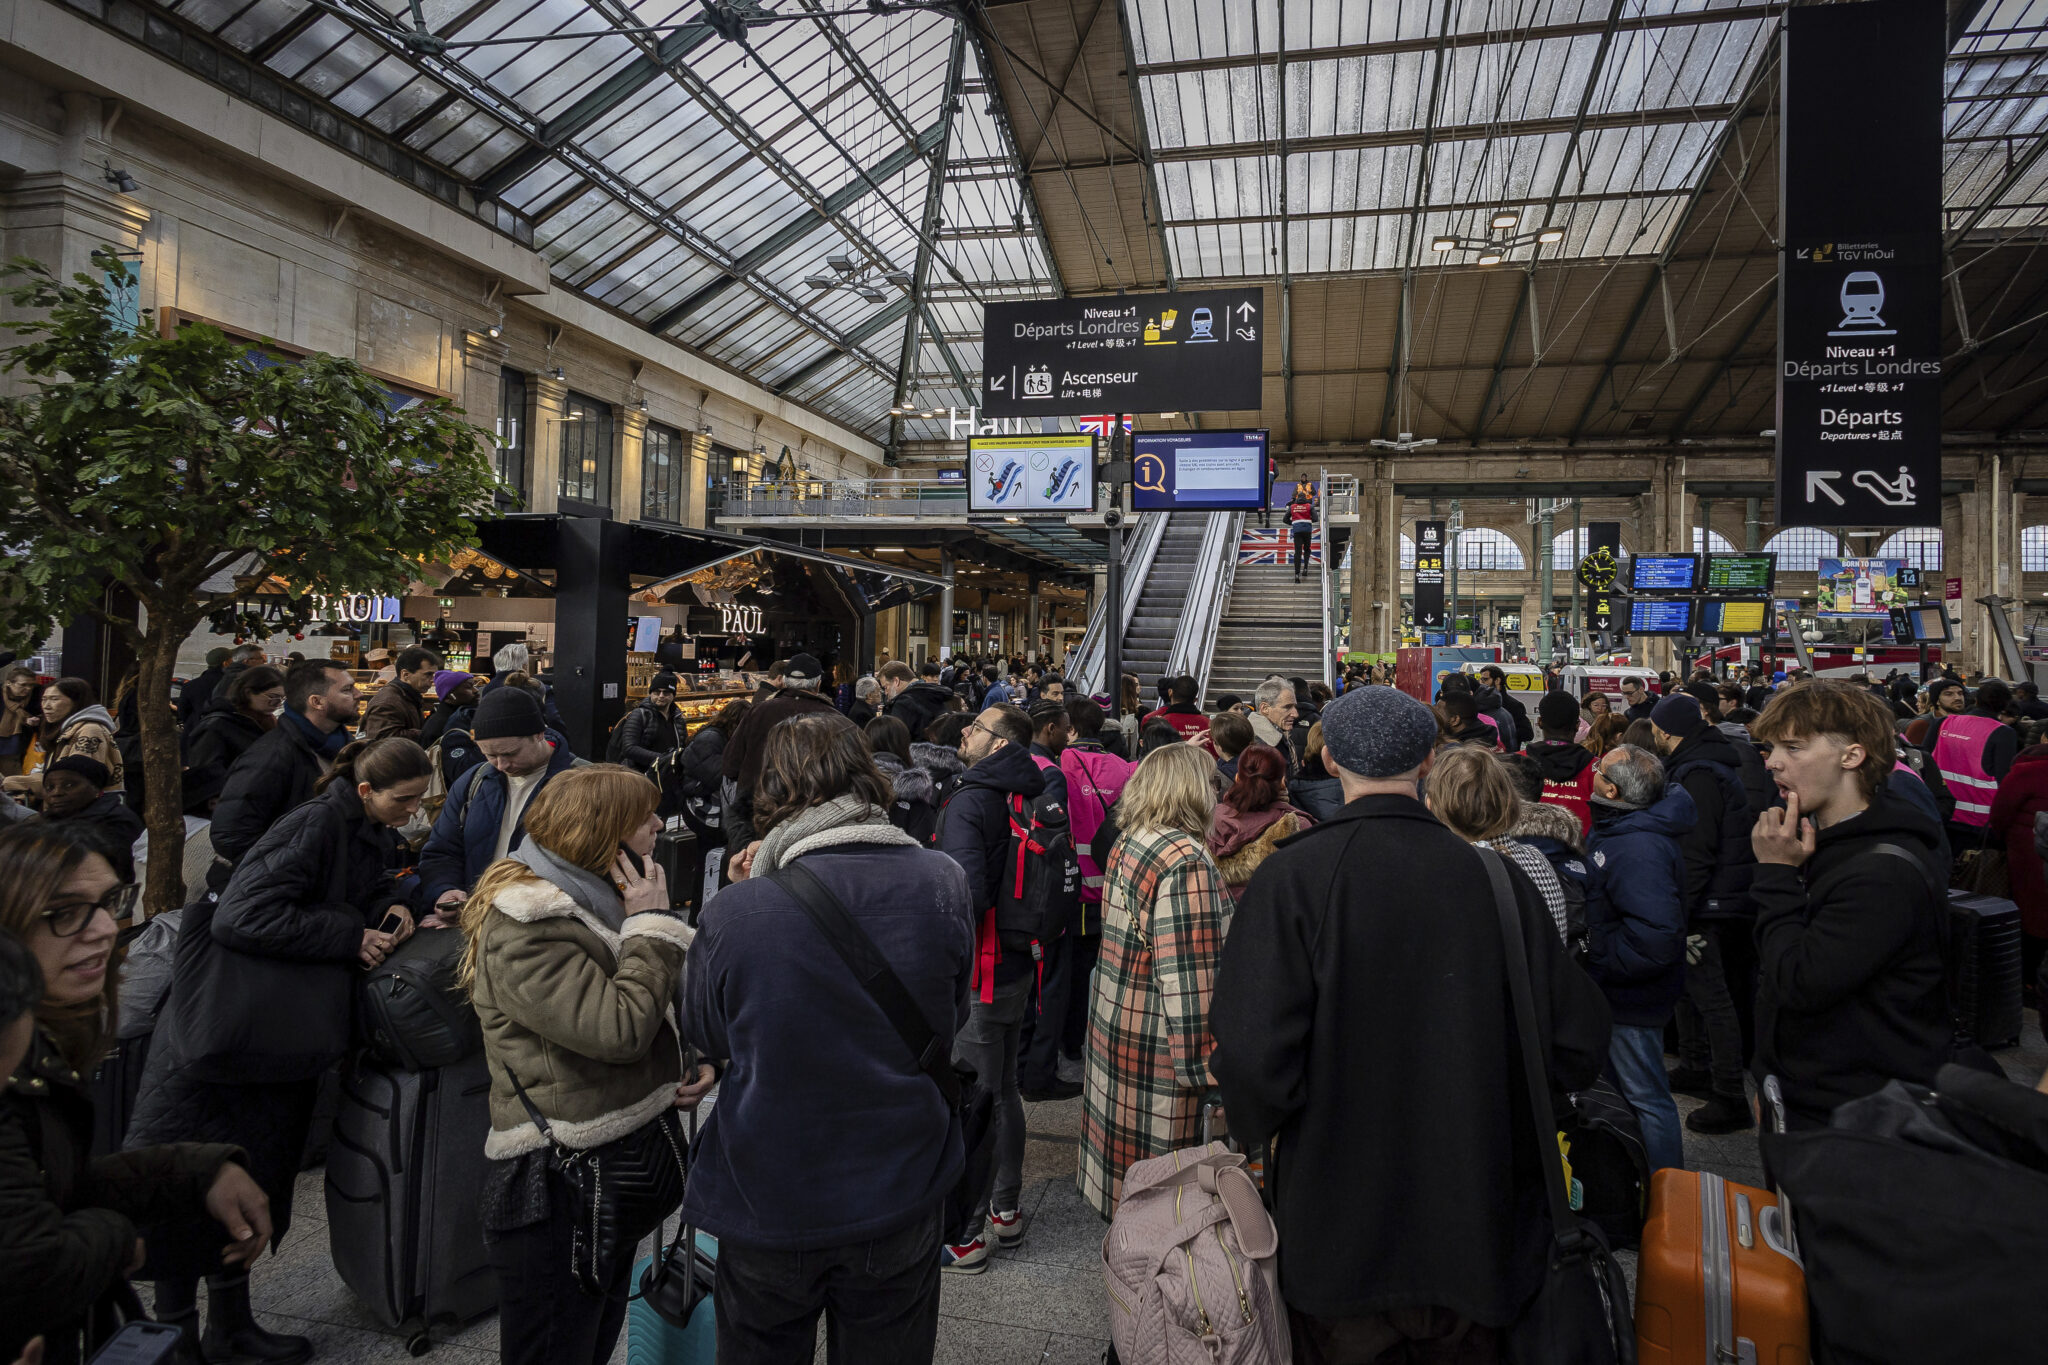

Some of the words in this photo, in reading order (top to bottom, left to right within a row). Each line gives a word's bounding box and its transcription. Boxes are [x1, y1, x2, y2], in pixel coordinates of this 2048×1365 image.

[1837, 242, 1878, 250] Billetteries
[1837, 251, 1860, 261] TGV
[1864, 250, 1894, 260] InOui
[1084, 308, 1120, 319] Niveau
[1123, 306, 1136, 317] +1
[1014, 322, 1074, 340] Départs
[1079, 319, 1140, 335] Londres
[1078, 340, 1098, 348] Level
[1105, 338, 1126, 348] 等级
[1126, 339, 1136, 348] +1
[1826, 346, 1874, 358] Niveau
[1878, 345, 1895, 356] +1
[1784, 361, 1858, 380] Départs
[1865, 358, 1941, 375] Londres
[1062, 370, 1138, 386] Ascenseur
[1061, 390, 1074, 398] Lift
[1082, 388, 1102, 398] 电梯
[1819, 384, 1831, 392] +1
[1832, 383, 1856, 392] Level
[1864, 382, 1888, 392] 等级
[1892, 383, 1904, 391] +1
[1820, 408, 1903, 429] Départs
[1820, 431, 1870, 442] Departures
[1878, 430, 1902, 441] 起点
[1901, 574, 1916, 584] 14
[310, 594, 395, 622] PAUL
[722, 608, 766, 634] PAUL
[1895, 622, 1906, 632] 14
